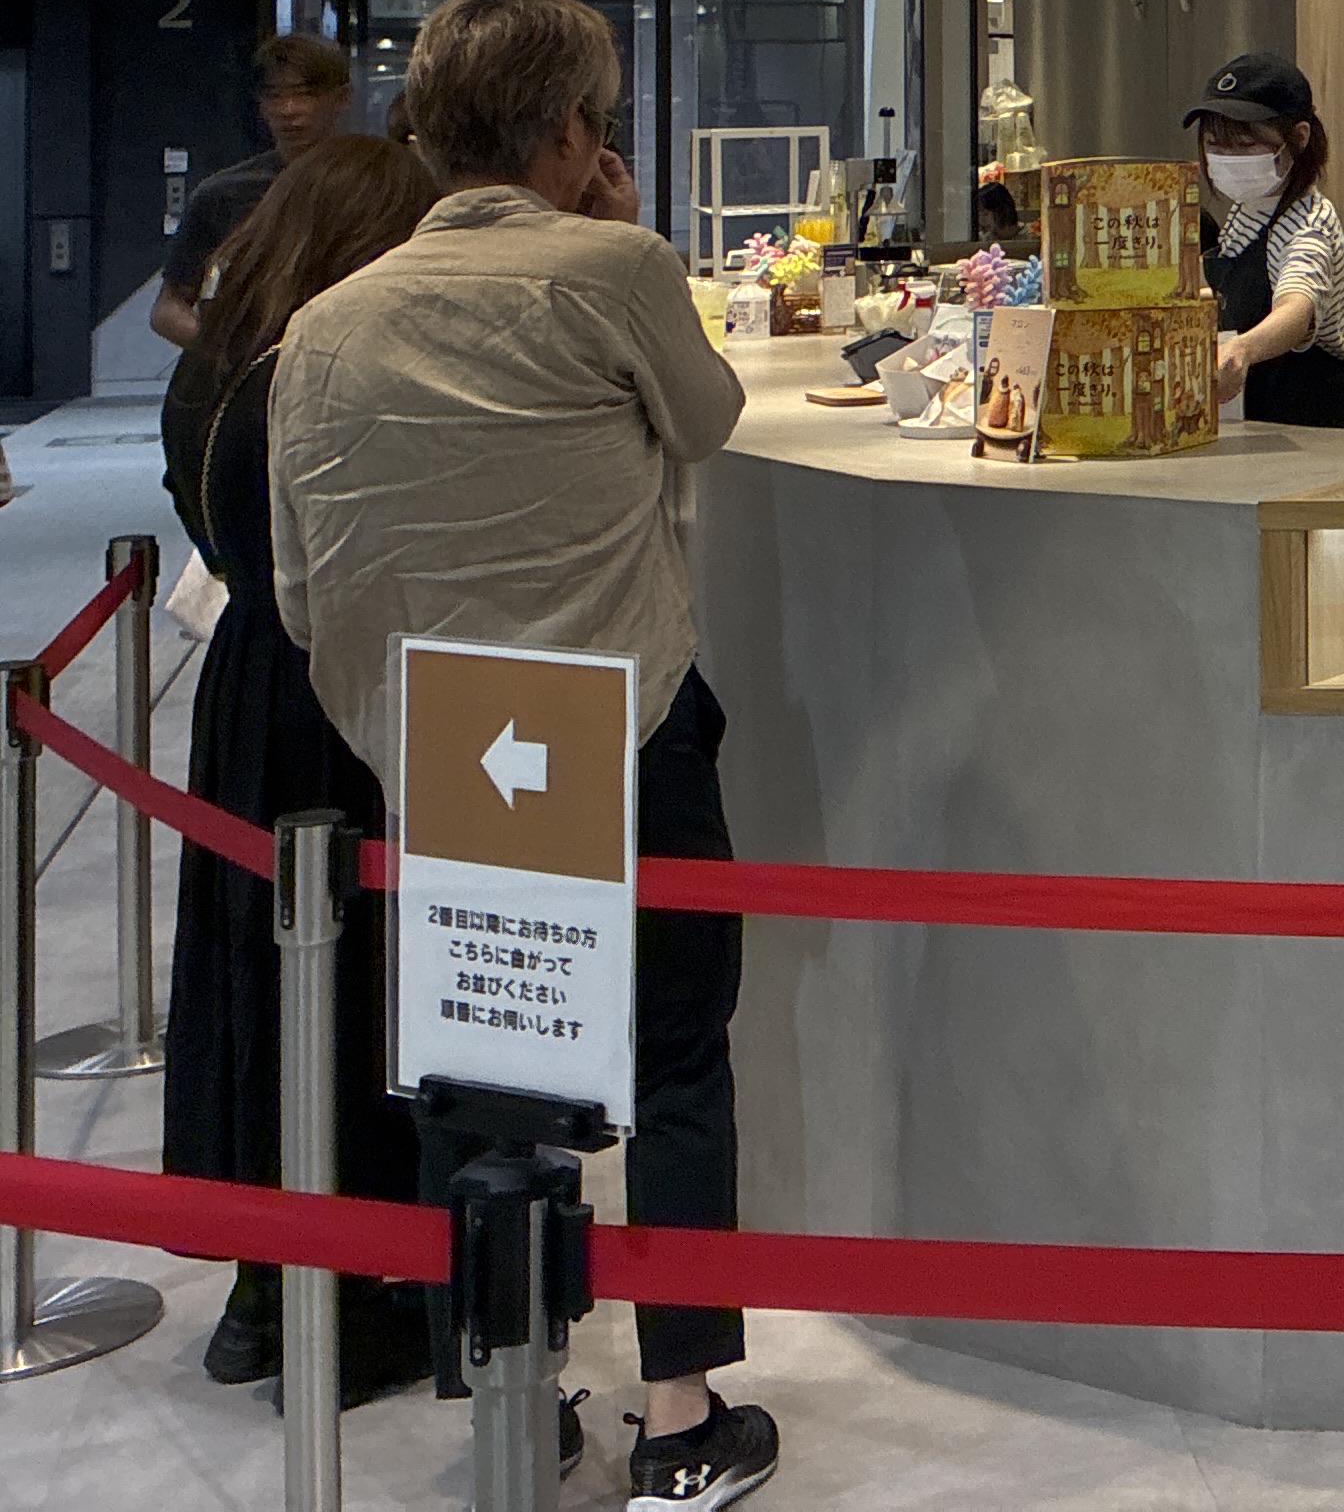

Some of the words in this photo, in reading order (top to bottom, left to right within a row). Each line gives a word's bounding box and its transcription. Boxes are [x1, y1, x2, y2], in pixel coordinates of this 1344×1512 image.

[1092, 214, 1161, 231] この秋は
[1055, 361, 1115, 378] この秋は
[427, 904, 598, 950] 2番目以降にお待ちの方
[448, 939, 574, 977] こちらに曲がって
[456, 970, 567, 1007] お並びください
[440, 998, 583, 1041] 順番にお伺いします
